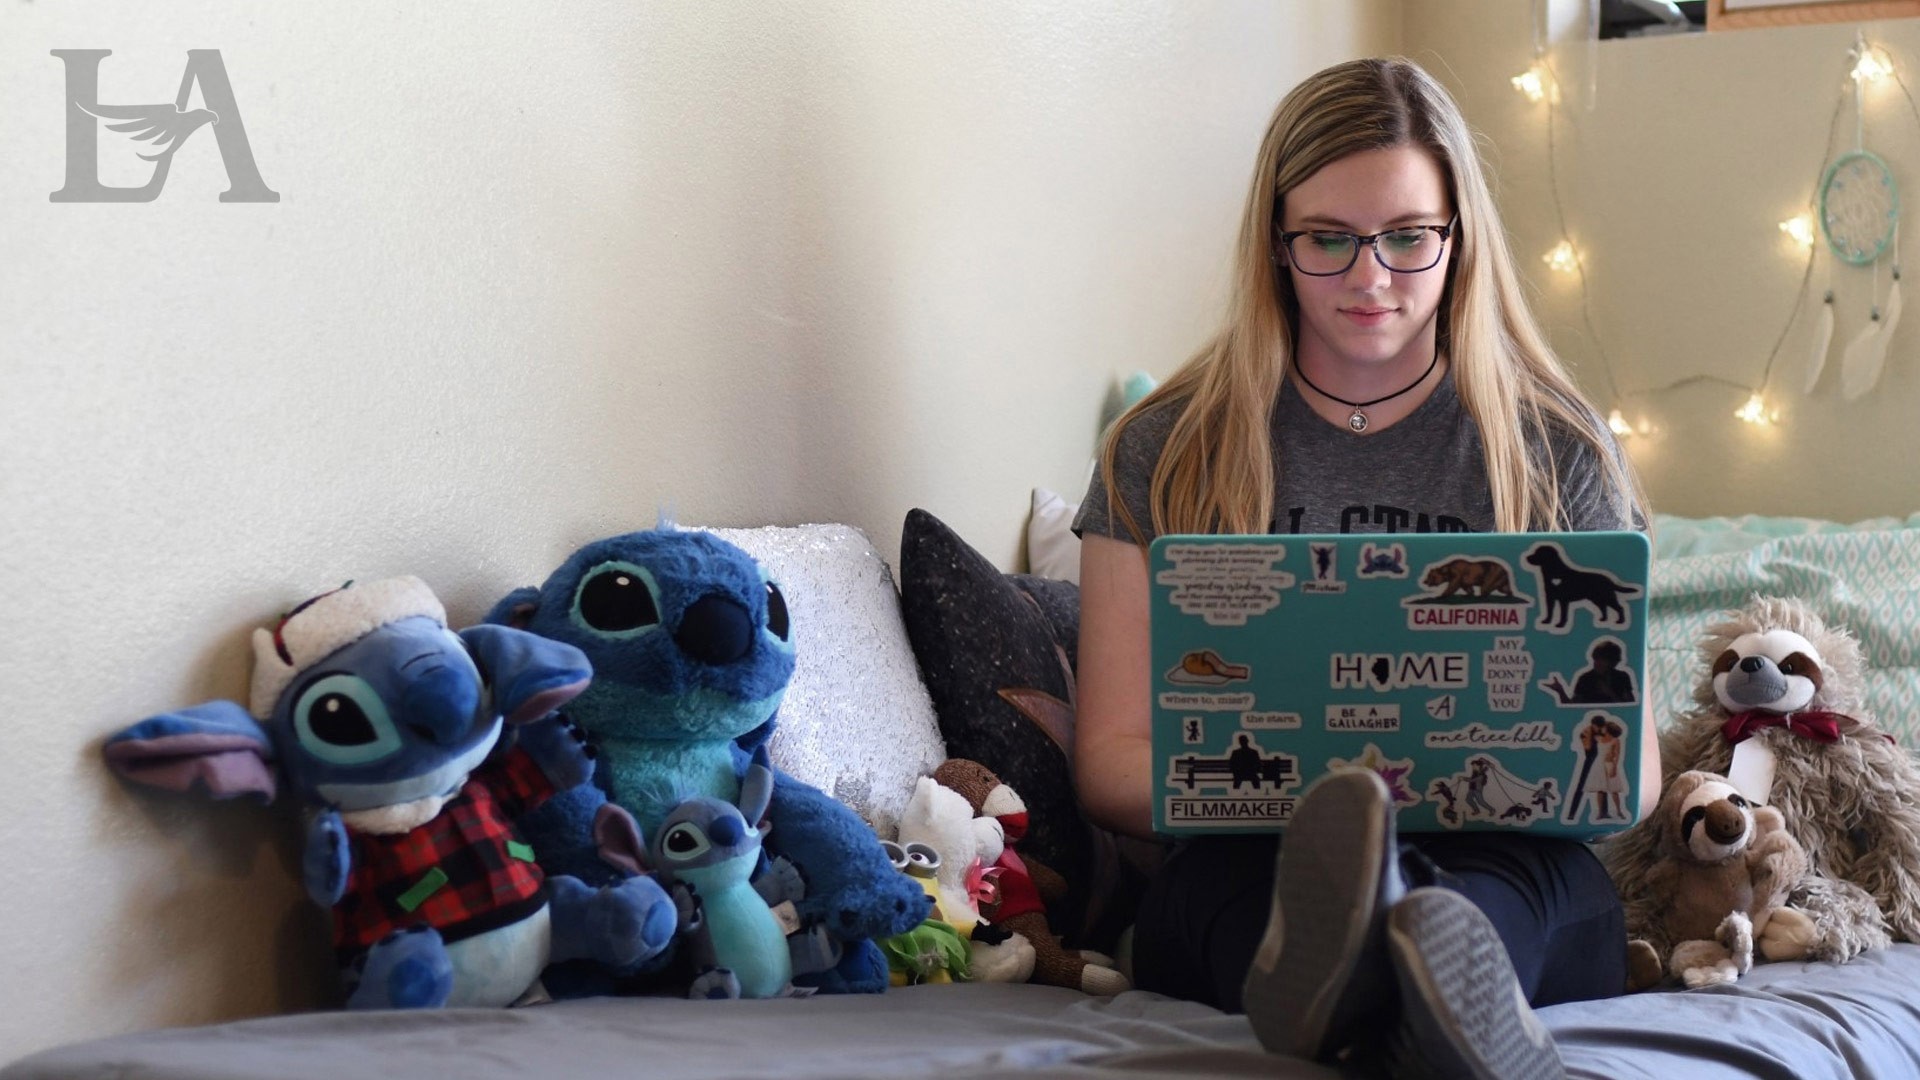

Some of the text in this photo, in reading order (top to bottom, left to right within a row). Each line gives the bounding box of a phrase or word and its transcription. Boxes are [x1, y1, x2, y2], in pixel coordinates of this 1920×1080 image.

[1413, 608, 1519, 625] CALIFORNIA
[1499, 640, 1521, 650] MY
[1487, 654, 1529, 665] MAMA
[1487, 669, 1529, 680] DON'T
[1492, 684, 1522, 694] LIKE
[1165, 695, 1198, 704] where
[1492, 699, 1520, 709] YOU
[1341, 707, 1378, 717] BE A
[1246, 715, 1264, 723] the
[1328, 718, 1399, 729] GALLAGHER
[1171, 802, 1294, 817] FILMMAKER
